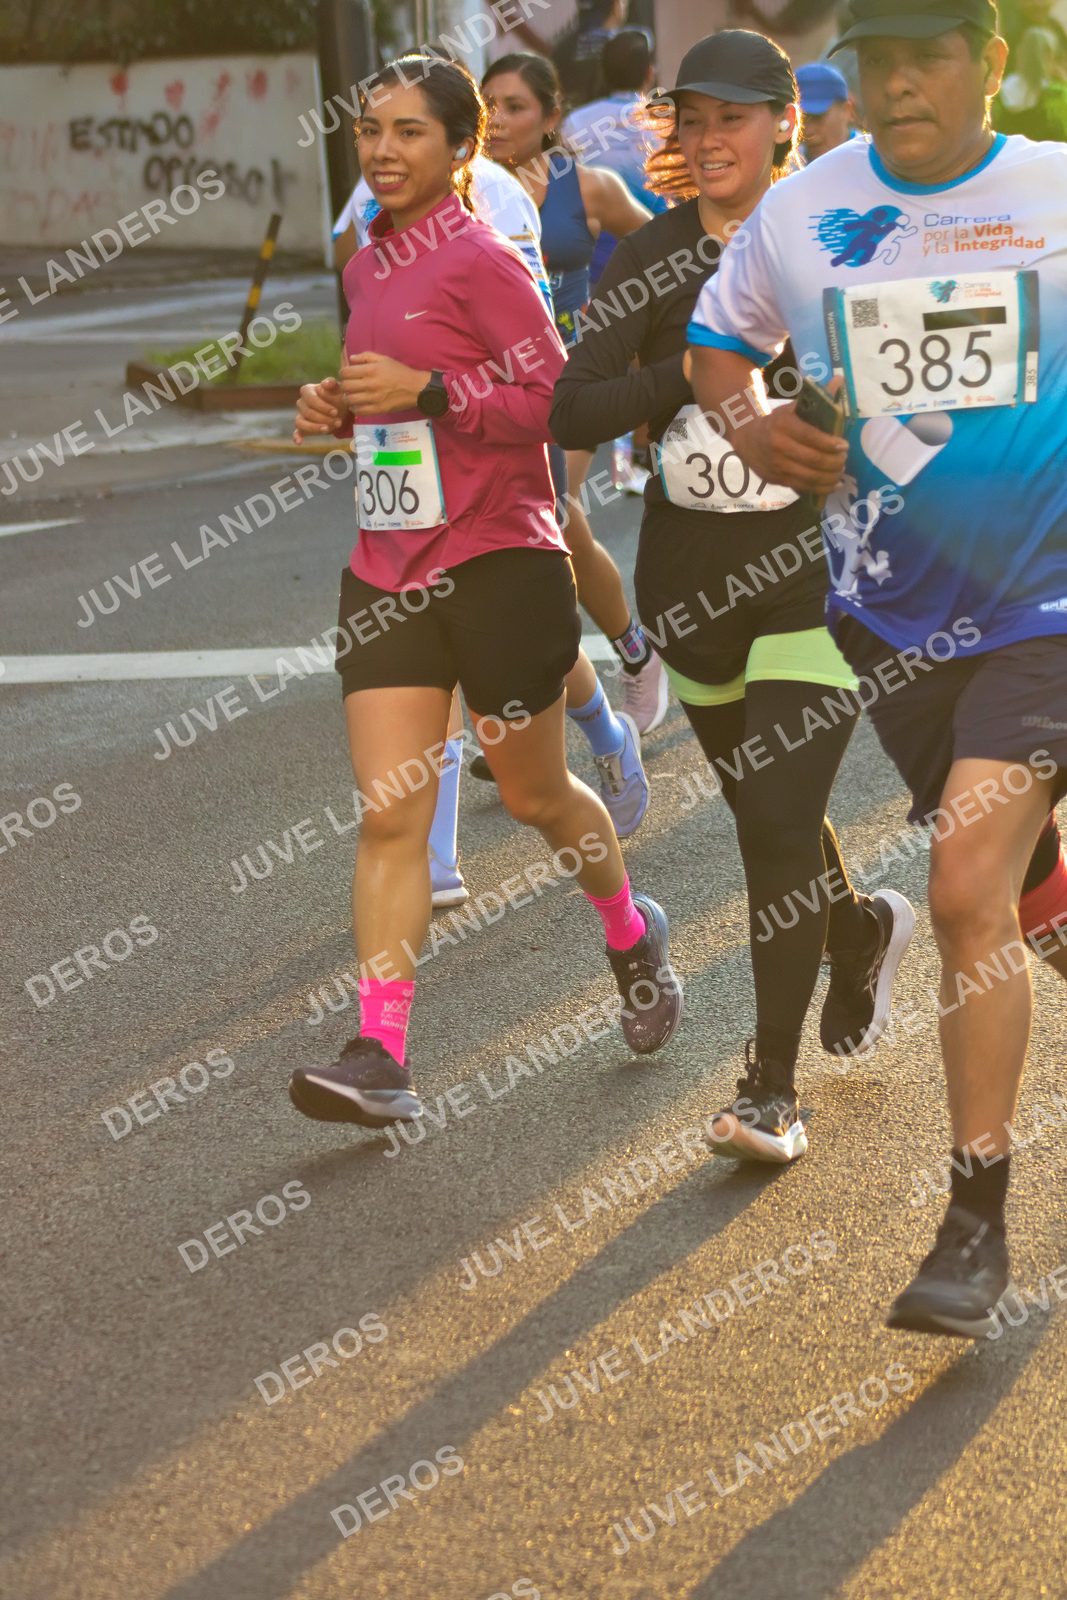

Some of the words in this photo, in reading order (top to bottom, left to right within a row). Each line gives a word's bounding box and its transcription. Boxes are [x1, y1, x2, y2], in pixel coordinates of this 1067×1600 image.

[924, 212, 1011, 227] Carrera
[924, 228, 950, 243] por
[954, 226, 970, 240] la
[972, 223, 1014, 238] Vida
[923, 245, 931, 257] y
[935, 240, 949, 253] la
[954, 236, 1045, 253] Integridad
[878, 330, 992, 397] 385
[359, 469, 420, 516] 306
